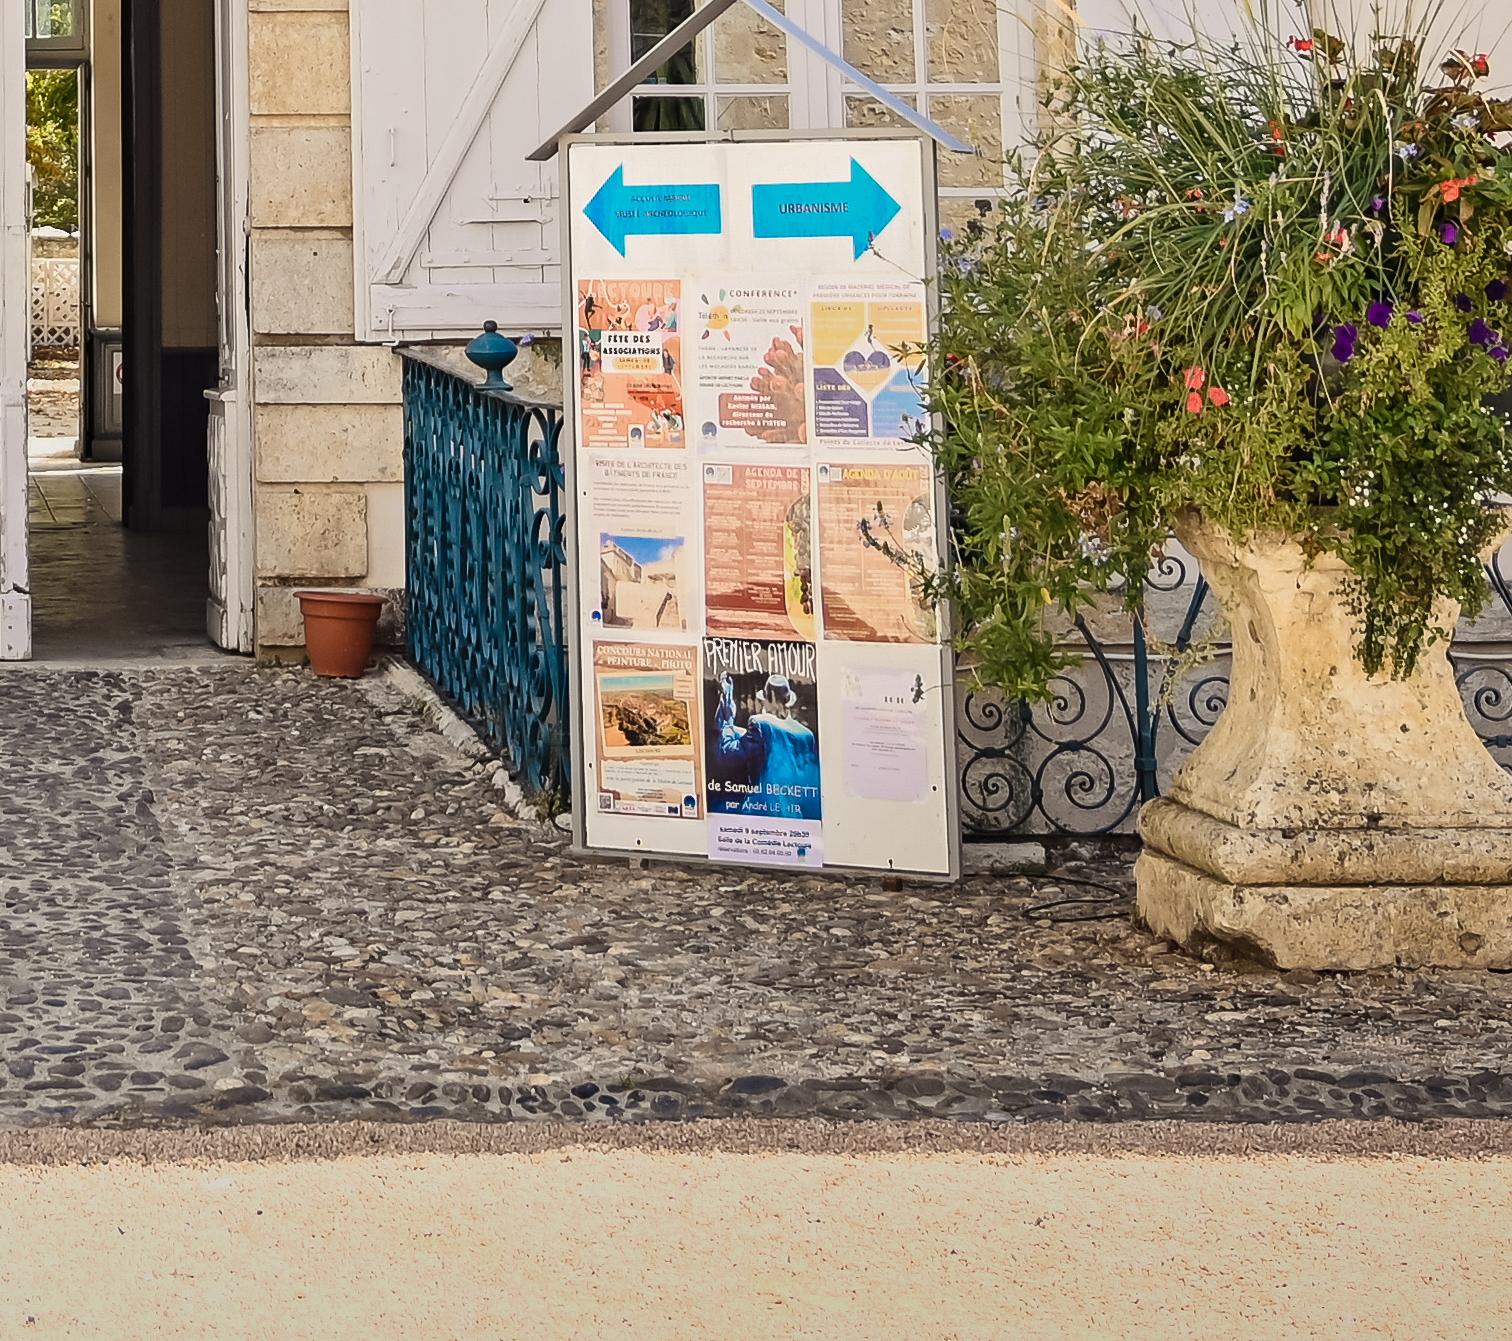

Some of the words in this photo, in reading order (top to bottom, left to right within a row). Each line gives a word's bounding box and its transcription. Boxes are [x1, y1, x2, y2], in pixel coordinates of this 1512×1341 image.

[779, 202, 849, 214] URBANISME
[633, 335, 651, 343] DES
[603, 347, 661, 355] ASSOCIATIONS
[595, 460, 615, 468] VISITE
[652, 471, 678, 479] FRANCE
[745, 468, 784, 478] AGENDA
[786, 469, 798, 479] DE
[843, 468, 880, 480] AGENDA
[883, 467, 919, 481] D'AOÛT
[745, 479, 799, 491] SEPTEMBRE
[597, 645, 646, 656] CONCOURS
[647, 648, 691, 659] NATIONAL
[607, 656, 652, 667] PEINTURE
[662, 659, 692, 669] PHOTO
[768, 641, 816, 683] AMOUR
[708, 779, 721, 791] de
[724, 780, 762, 794] Samuel
[766, 783, 818, 798] BECKETT
[725, 801, 739, 810] par
[742, 797, 768, 811] André
[751, 829, 787, 837] septembre
[752, 838, 781, 847] Comédie
[783, 840, 812, 849] Lectoure
